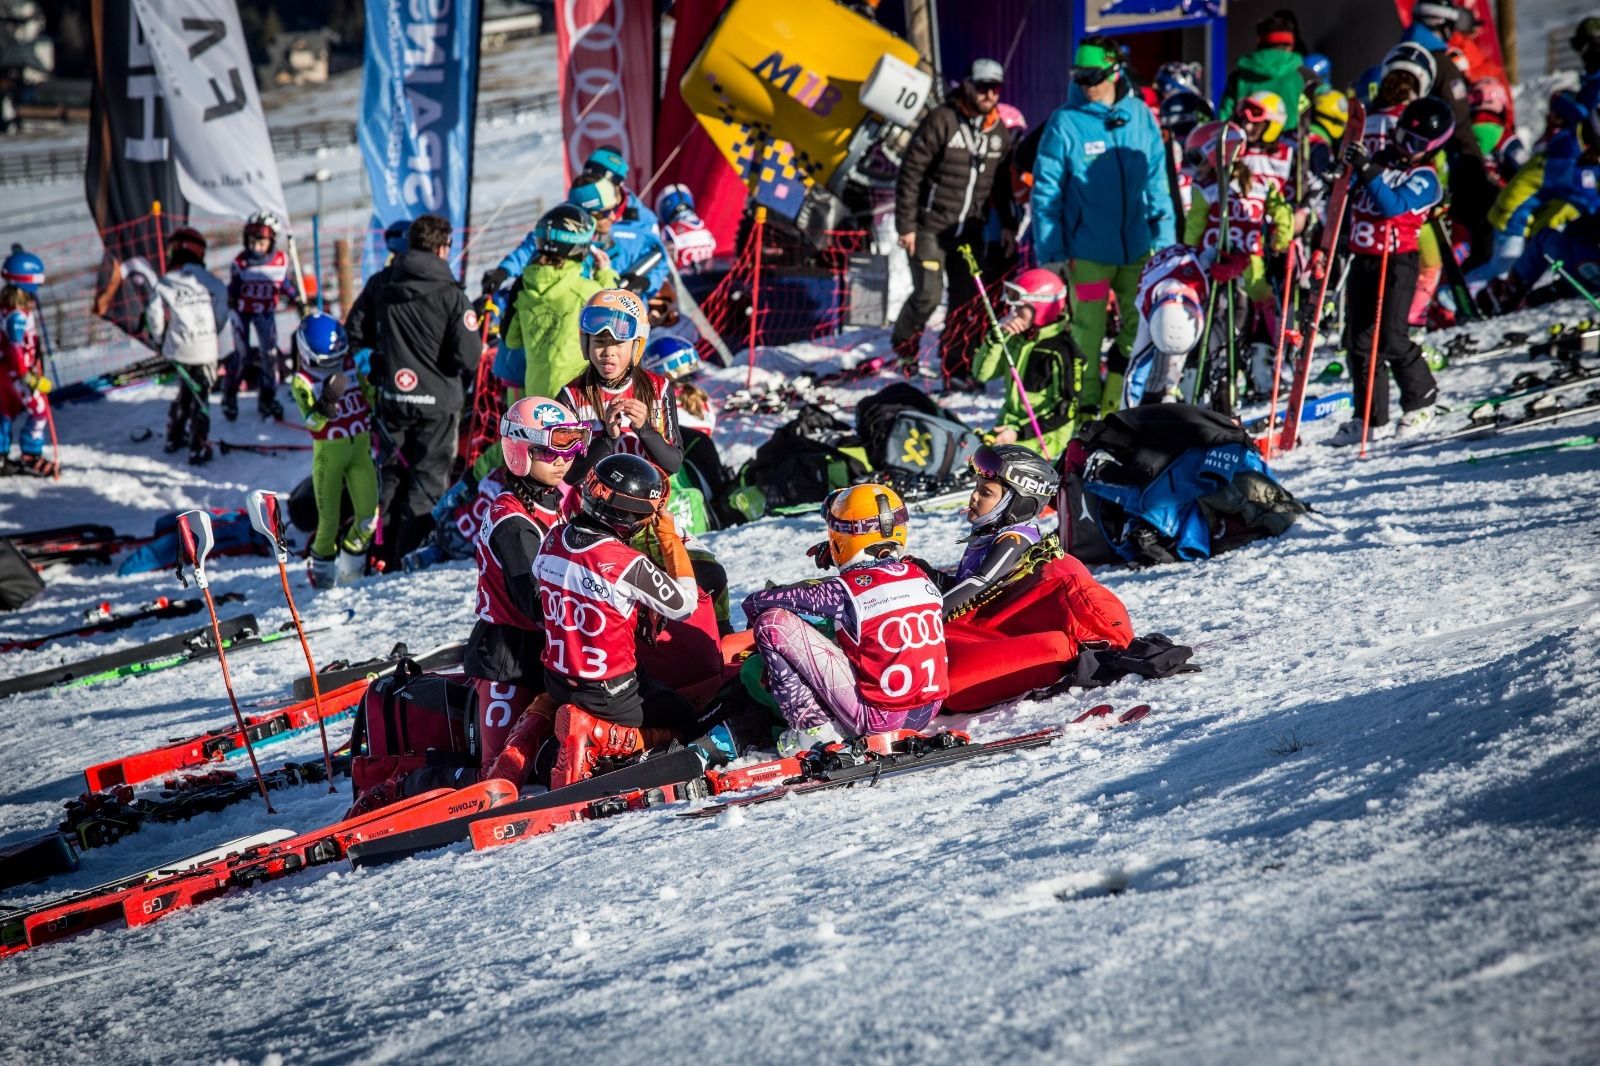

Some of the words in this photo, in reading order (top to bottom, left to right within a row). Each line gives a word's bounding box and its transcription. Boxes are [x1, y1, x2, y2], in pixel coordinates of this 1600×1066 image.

[896, 87, 918, 109] 10
[880, 657, 948, 697] 01
[448, 799, 478, 815] ATOMIC
